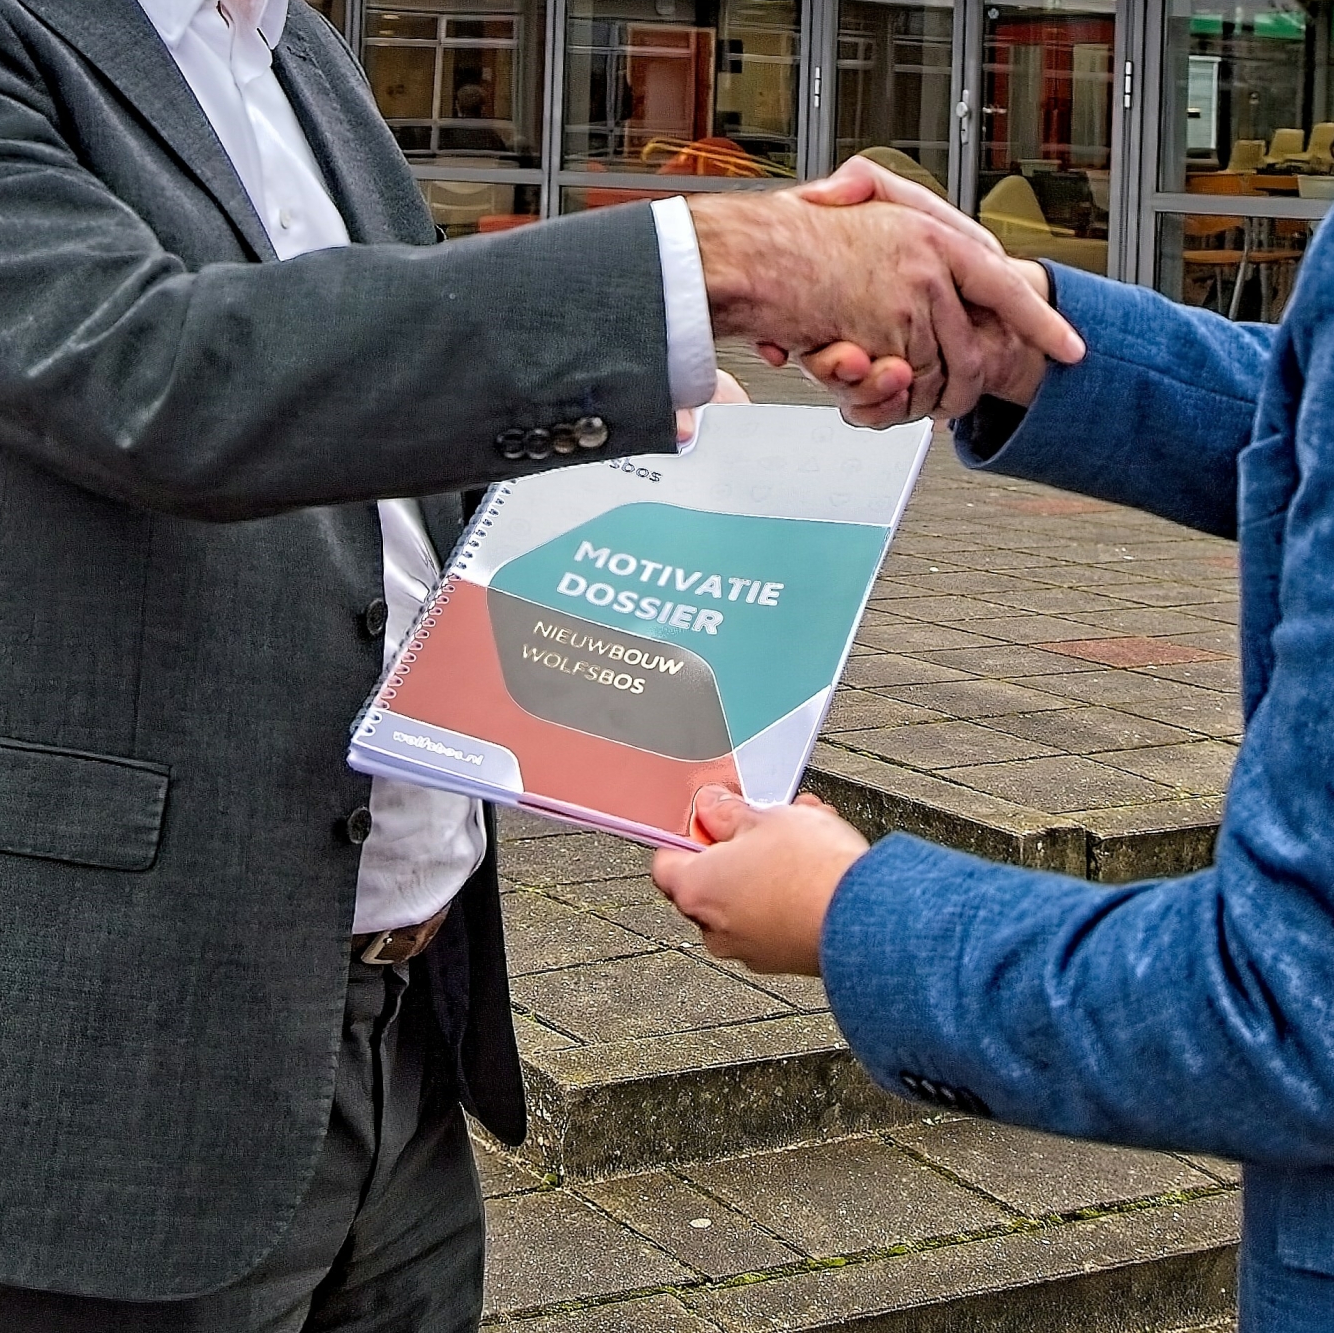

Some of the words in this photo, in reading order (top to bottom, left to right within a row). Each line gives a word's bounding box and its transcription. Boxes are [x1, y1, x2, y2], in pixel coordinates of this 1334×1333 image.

[600, 457, 662, 482] sbos
[573, 540, 785, 606] MOTIVATIE
[556, 571, 724, 635] DOSSIER
[522, 643, 646, 695] WOLFSBOS
[533, 620, 684, 675] NIEUWBOUW
[393, 730, 484, 766] wolfsbos.nl
